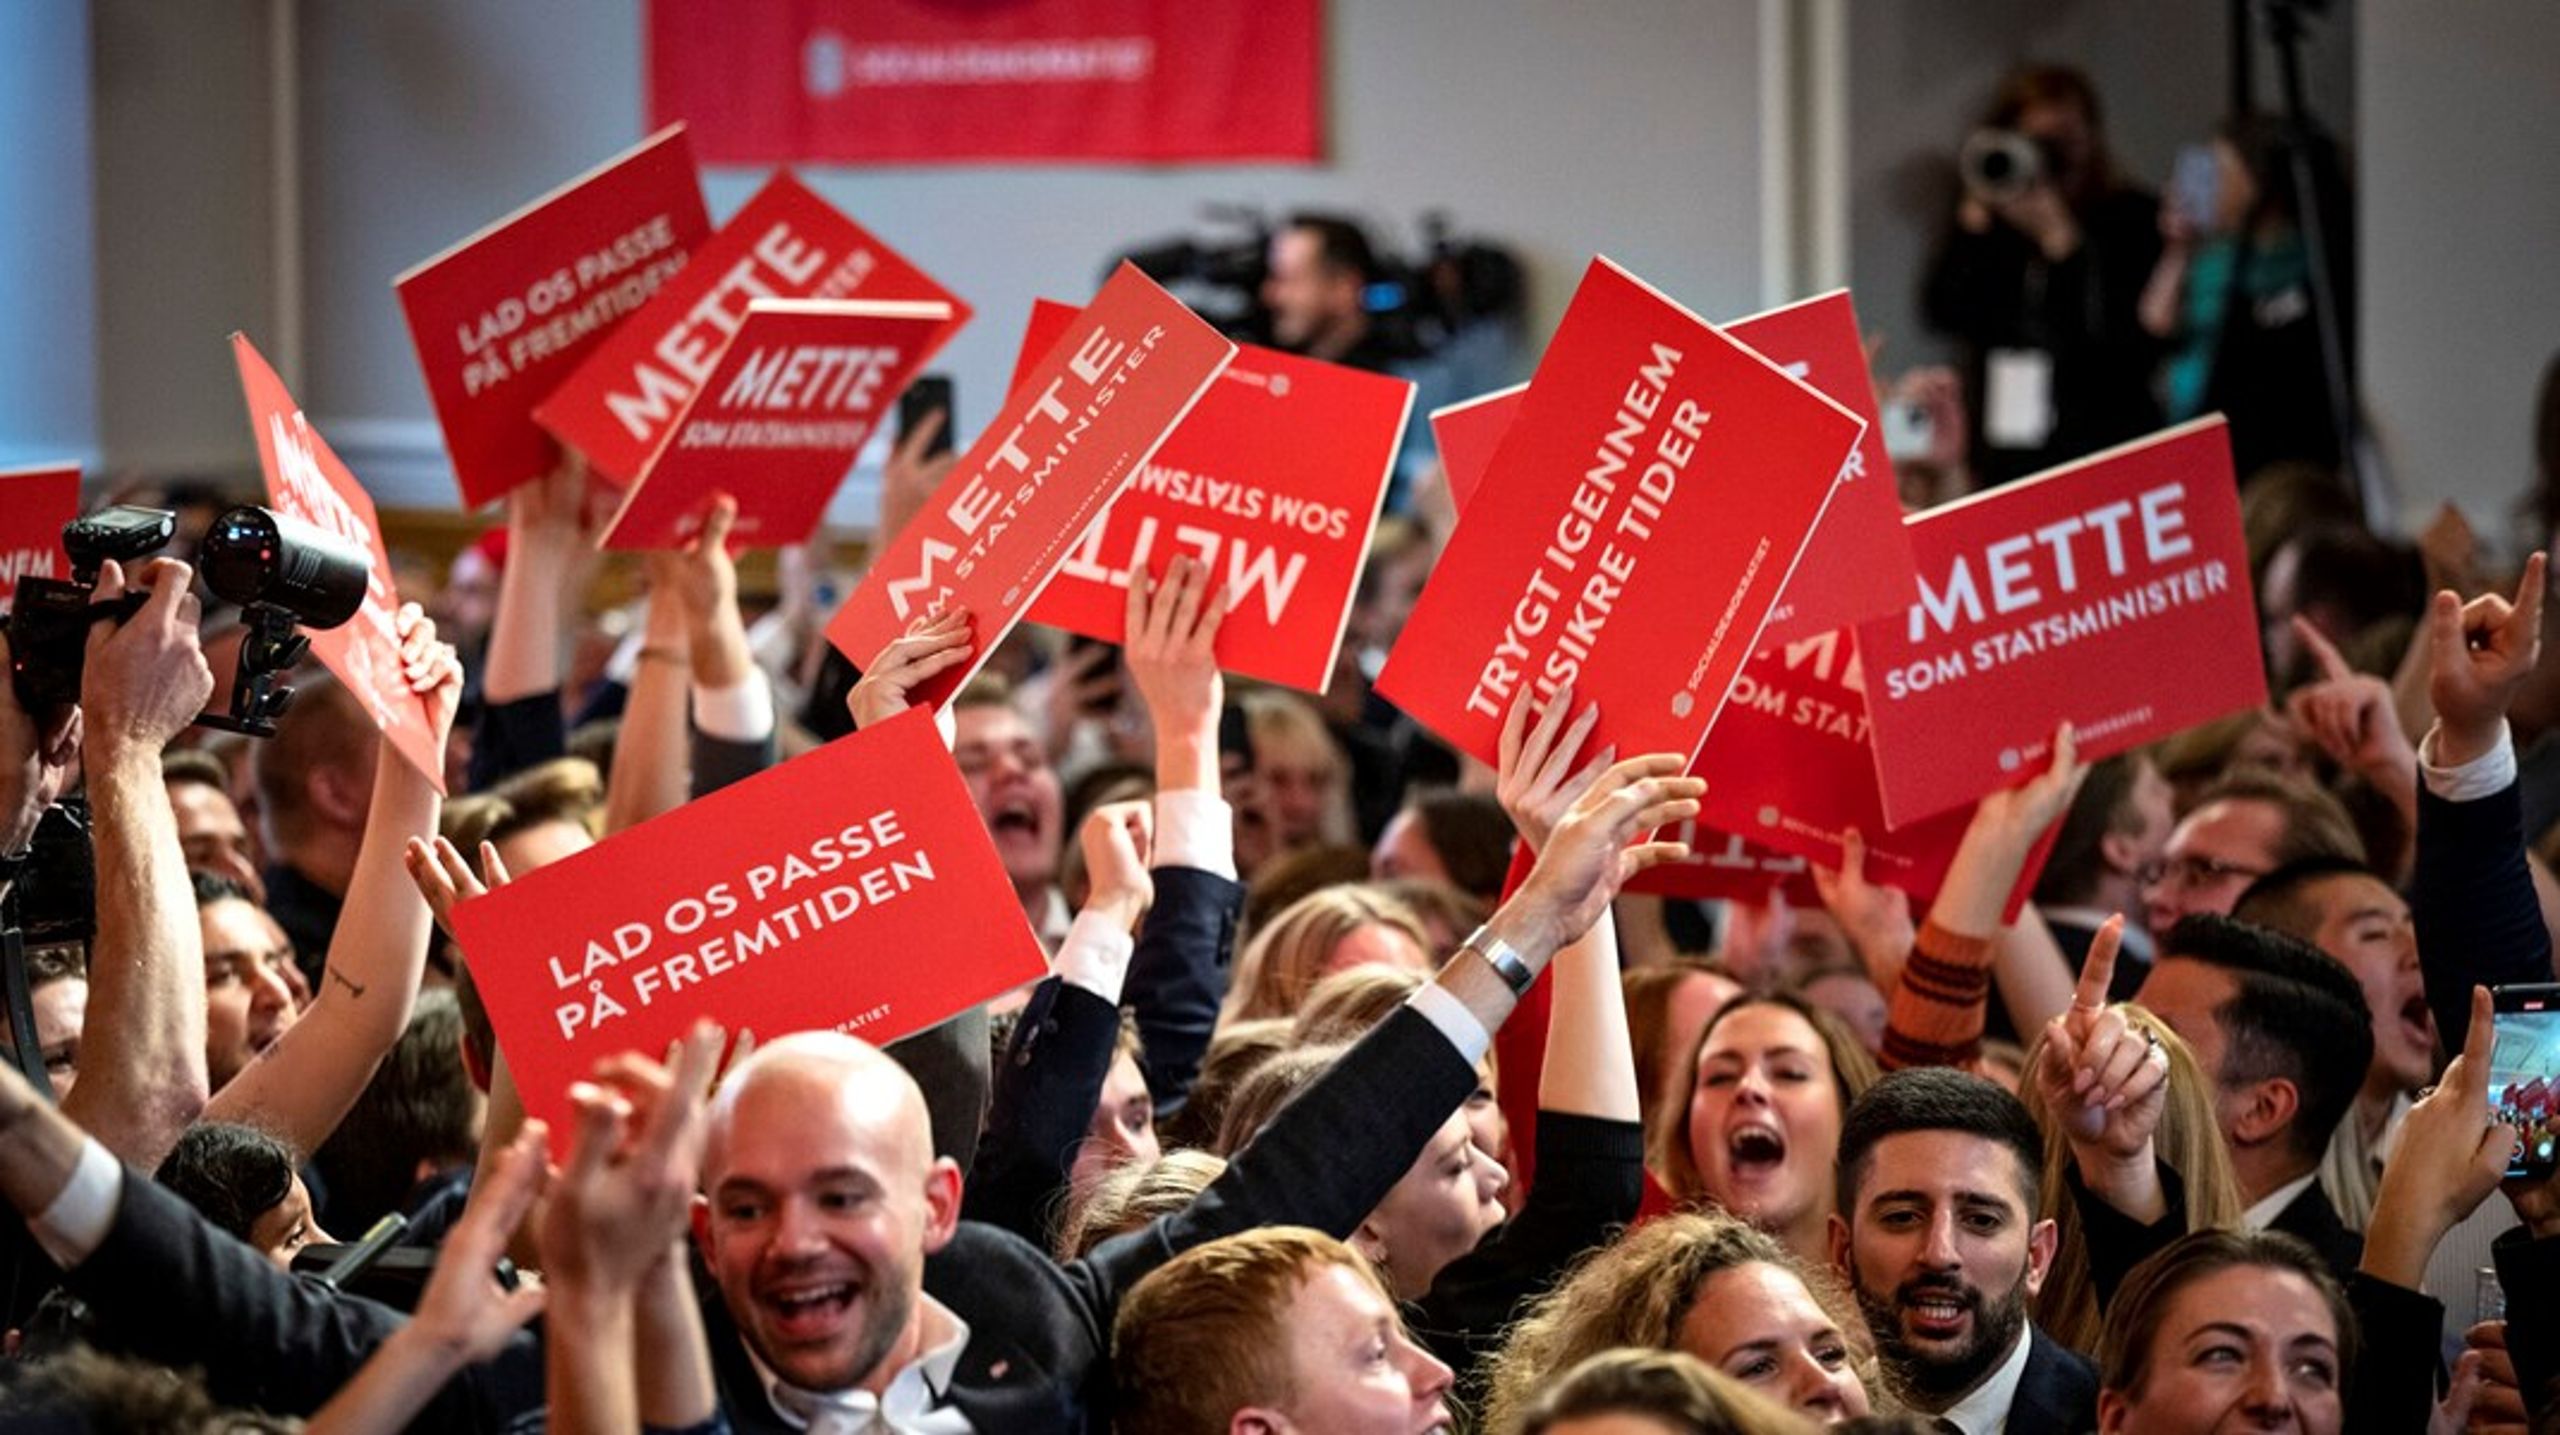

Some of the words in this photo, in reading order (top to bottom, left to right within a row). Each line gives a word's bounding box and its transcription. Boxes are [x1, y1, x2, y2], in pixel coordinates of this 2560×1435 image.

[457, 297, 525, 355] LAD
[527, 267, 576, 315] OS
[576, 213, 675, 289] PASSE
[605, 222, 827, 443] METTE
[720, 346, 899, 409] METTE
[955, 325, 1166, 580] STATSMINISTER
[887, 326, 1125, 622] METTE
[1270, 495, 1350, 539] SOM
[1465, 568, 1560, 718] TRYGT
[1545, 342, 1683, 571] IGENNEM
[1617, 399, 1711, 542] TIDER
[1887, 651, 1967, 700] SOM
[1973, 560, 2230, 672] STATSMINISTER
[1908, 482, 2194, 643] METTE
[1729, 674, 1787, 717] OM
[548, 921, 653, 991] LAD
[665, 883, 739, 935] OS
[746, 810, 906, 902] PASSE
[555, 979, 627, 1041] PÅ
[632, 850, 936, 1006] FREMTIDEN
